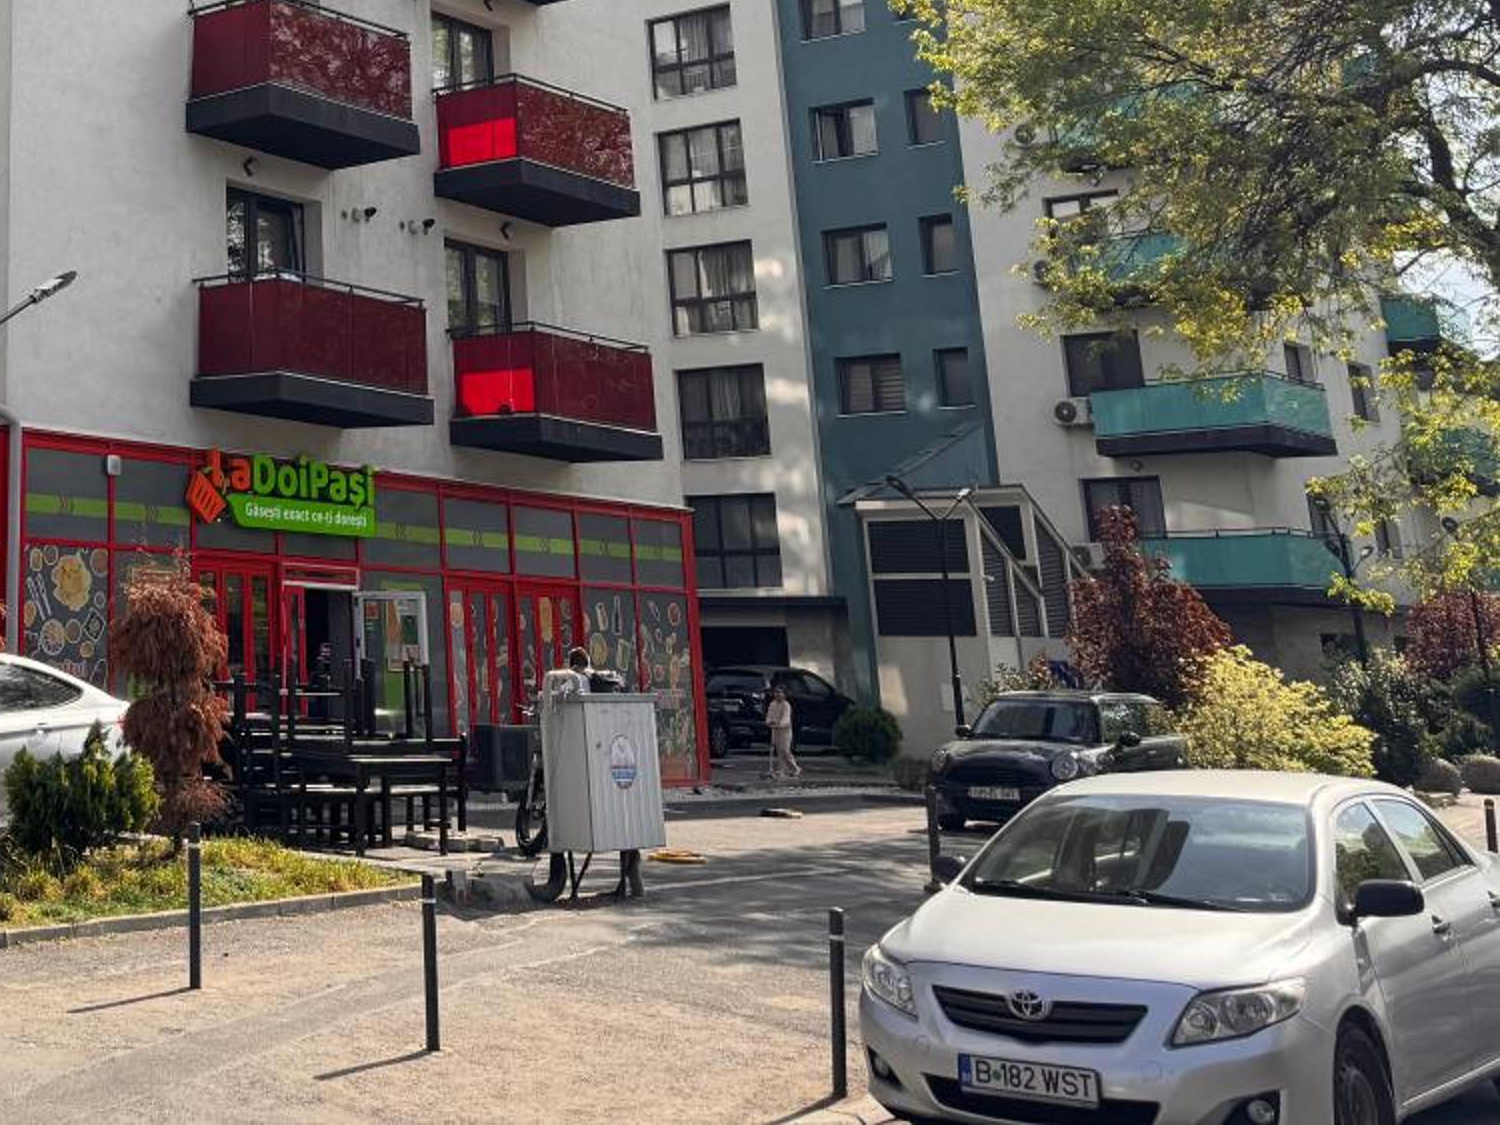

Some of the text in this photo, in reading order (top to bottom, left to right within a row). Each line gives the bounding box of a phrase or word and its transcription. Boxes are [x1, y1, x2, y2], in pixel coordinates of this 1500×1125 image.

[283, 509, 310, 521] exact
[975, 1060, 1092, 1097] B 182 WST
